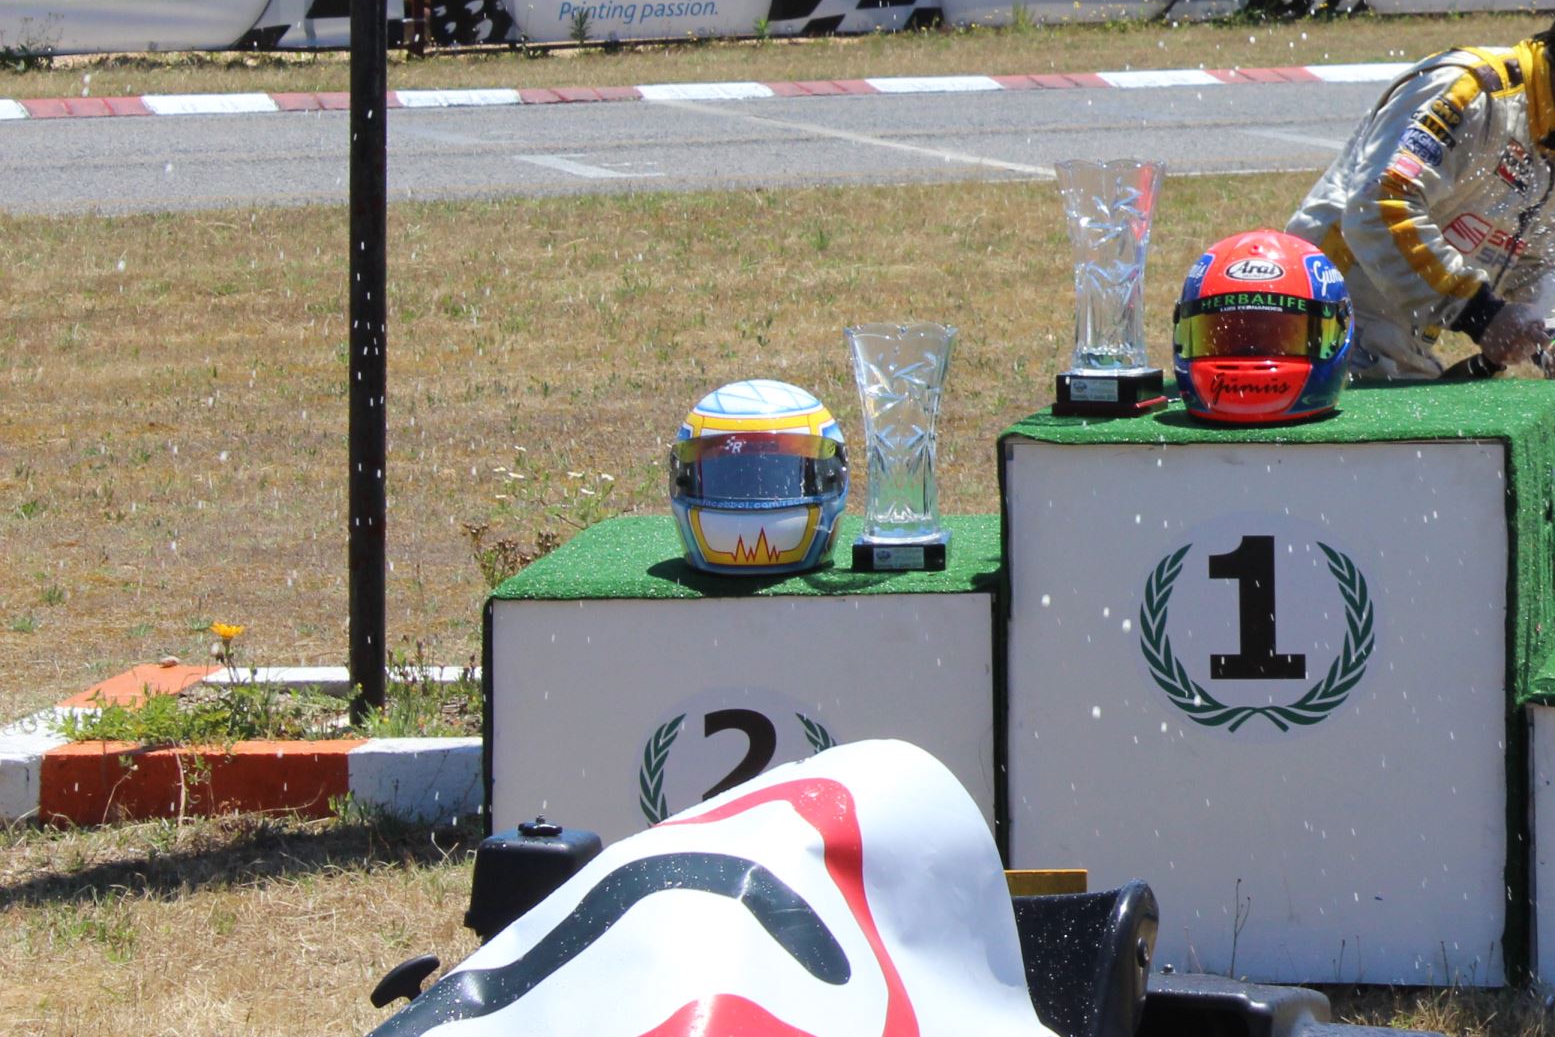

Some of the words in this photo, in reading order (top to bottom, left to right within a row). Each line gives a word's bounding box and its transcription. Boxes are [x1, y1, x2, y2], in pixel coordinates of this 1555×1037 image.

[558, 0, 637, 25] Printing
[1236, 261, 1276, 275] Arai
[1202, 293, 1307, 312] HERBALIFE
[1209, 535, 1306, 679] 1
[702, 708, 777, 802] 2
